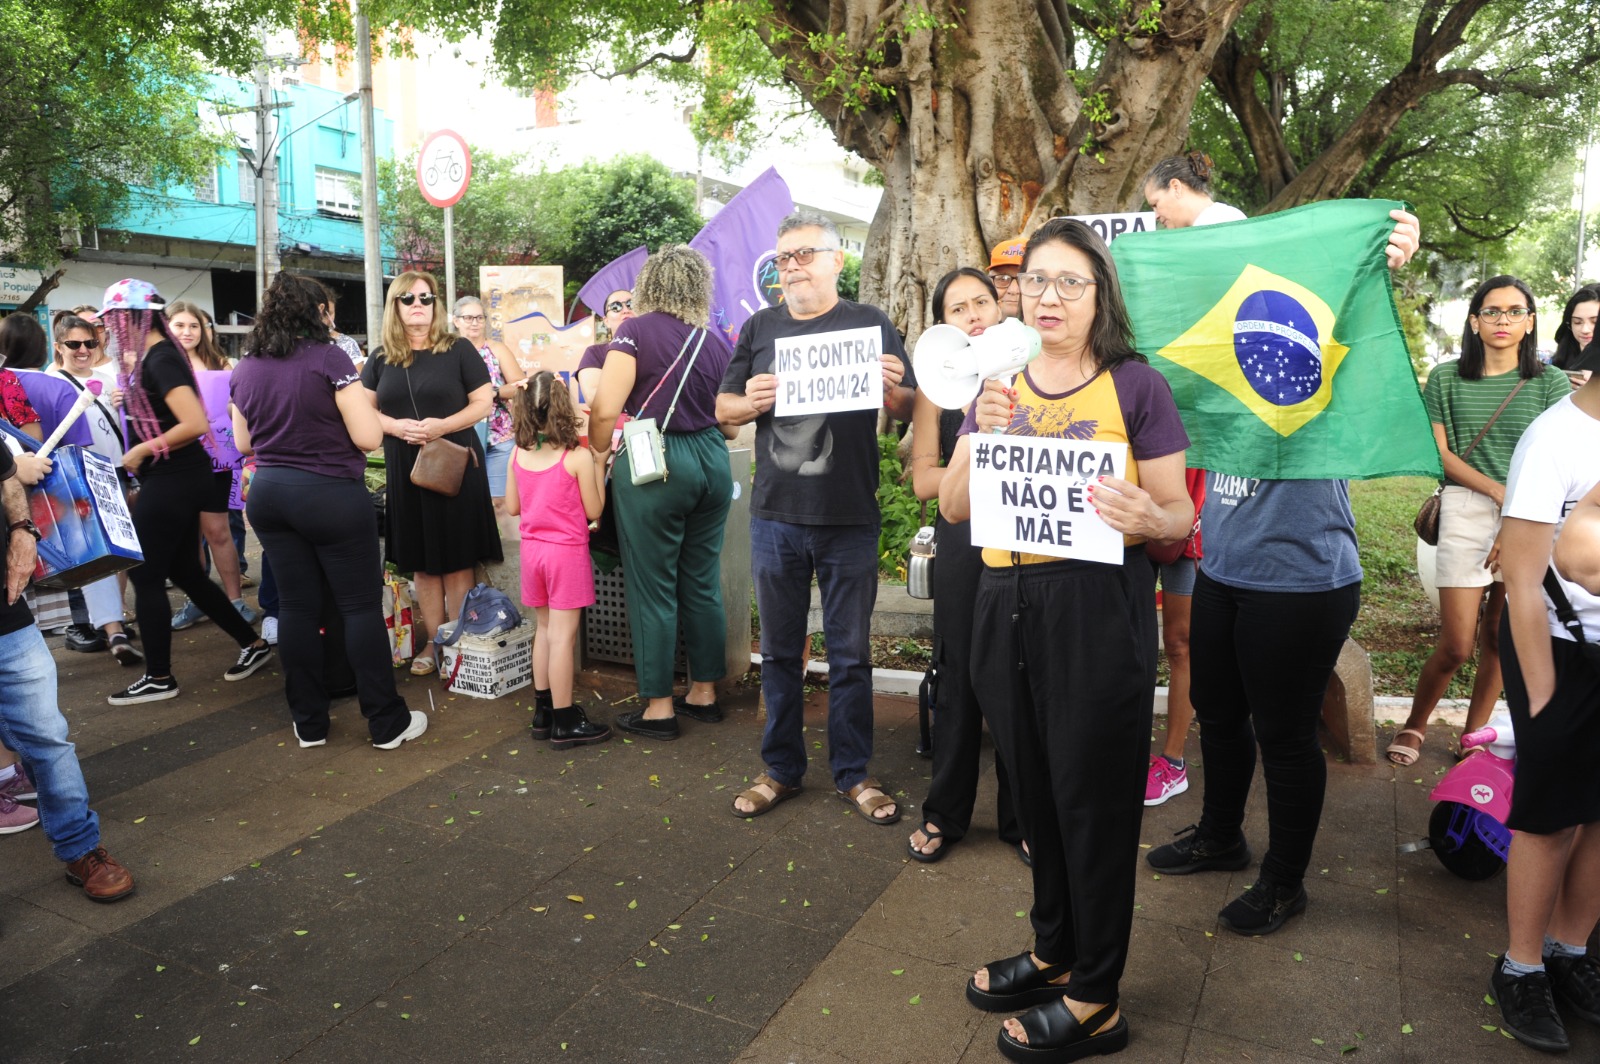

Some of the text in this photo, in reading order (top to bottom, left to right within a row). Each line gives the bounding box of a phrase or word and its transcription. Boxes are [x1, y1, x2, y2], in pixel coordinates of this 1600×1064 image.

[1083, 217, 1146, 241] ORA
[1001, 249, 1025, 257] Hurle
[3, 281, 41, 293] Popula
[778, 338, 878, 373] MS CONTRA
[1237, 321, 1321, 357] ORDEM E PROGRESSO
[786, 371, 870, 405] PL1904/24
[976, 443, 1115, 486] #CRIANÇA
[1001, 476, 1085, 513] NÃO É
[1015, 513, 1073, 547] MÃE
